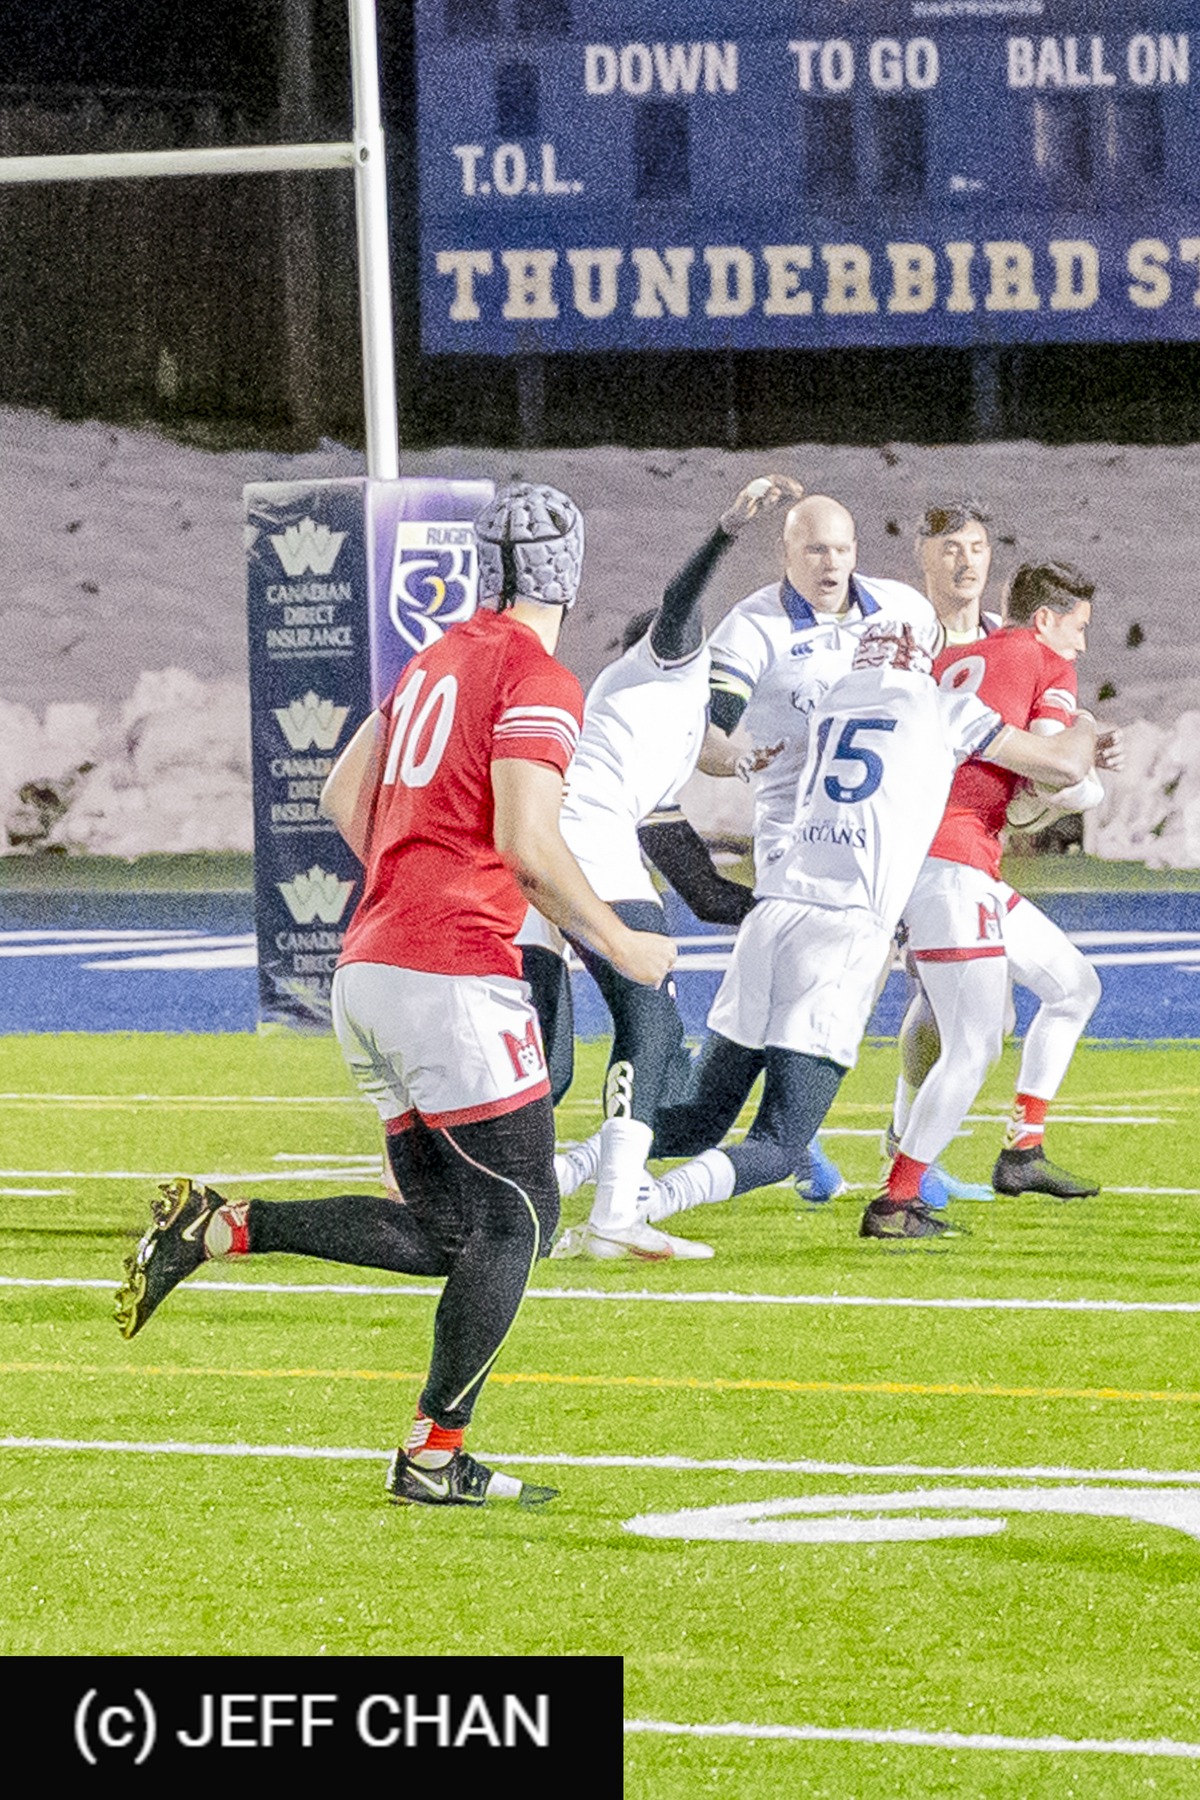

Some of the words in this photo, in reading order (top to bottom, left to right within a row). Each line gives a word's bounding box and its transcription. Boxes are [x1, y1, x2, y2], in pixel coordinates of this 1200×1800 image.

[585, 42, 738, 94] DOWN
[788, 38, 854, 91] TO
[869, 36, 940, 90] GO
[1007, 35, 1117, 88] BALL
[1127, 33, 1190, 86] ON
[452, 143, 584, 196] T.O.L.
[436, 240, 1099, 322] THUNDERBIRD
[265, 582, 352, 604] CANADIAN
[284, 604, 335, 626] DIRECT
[383, 668, 458, 788] 10
[802, 717, 898, 804] 15
